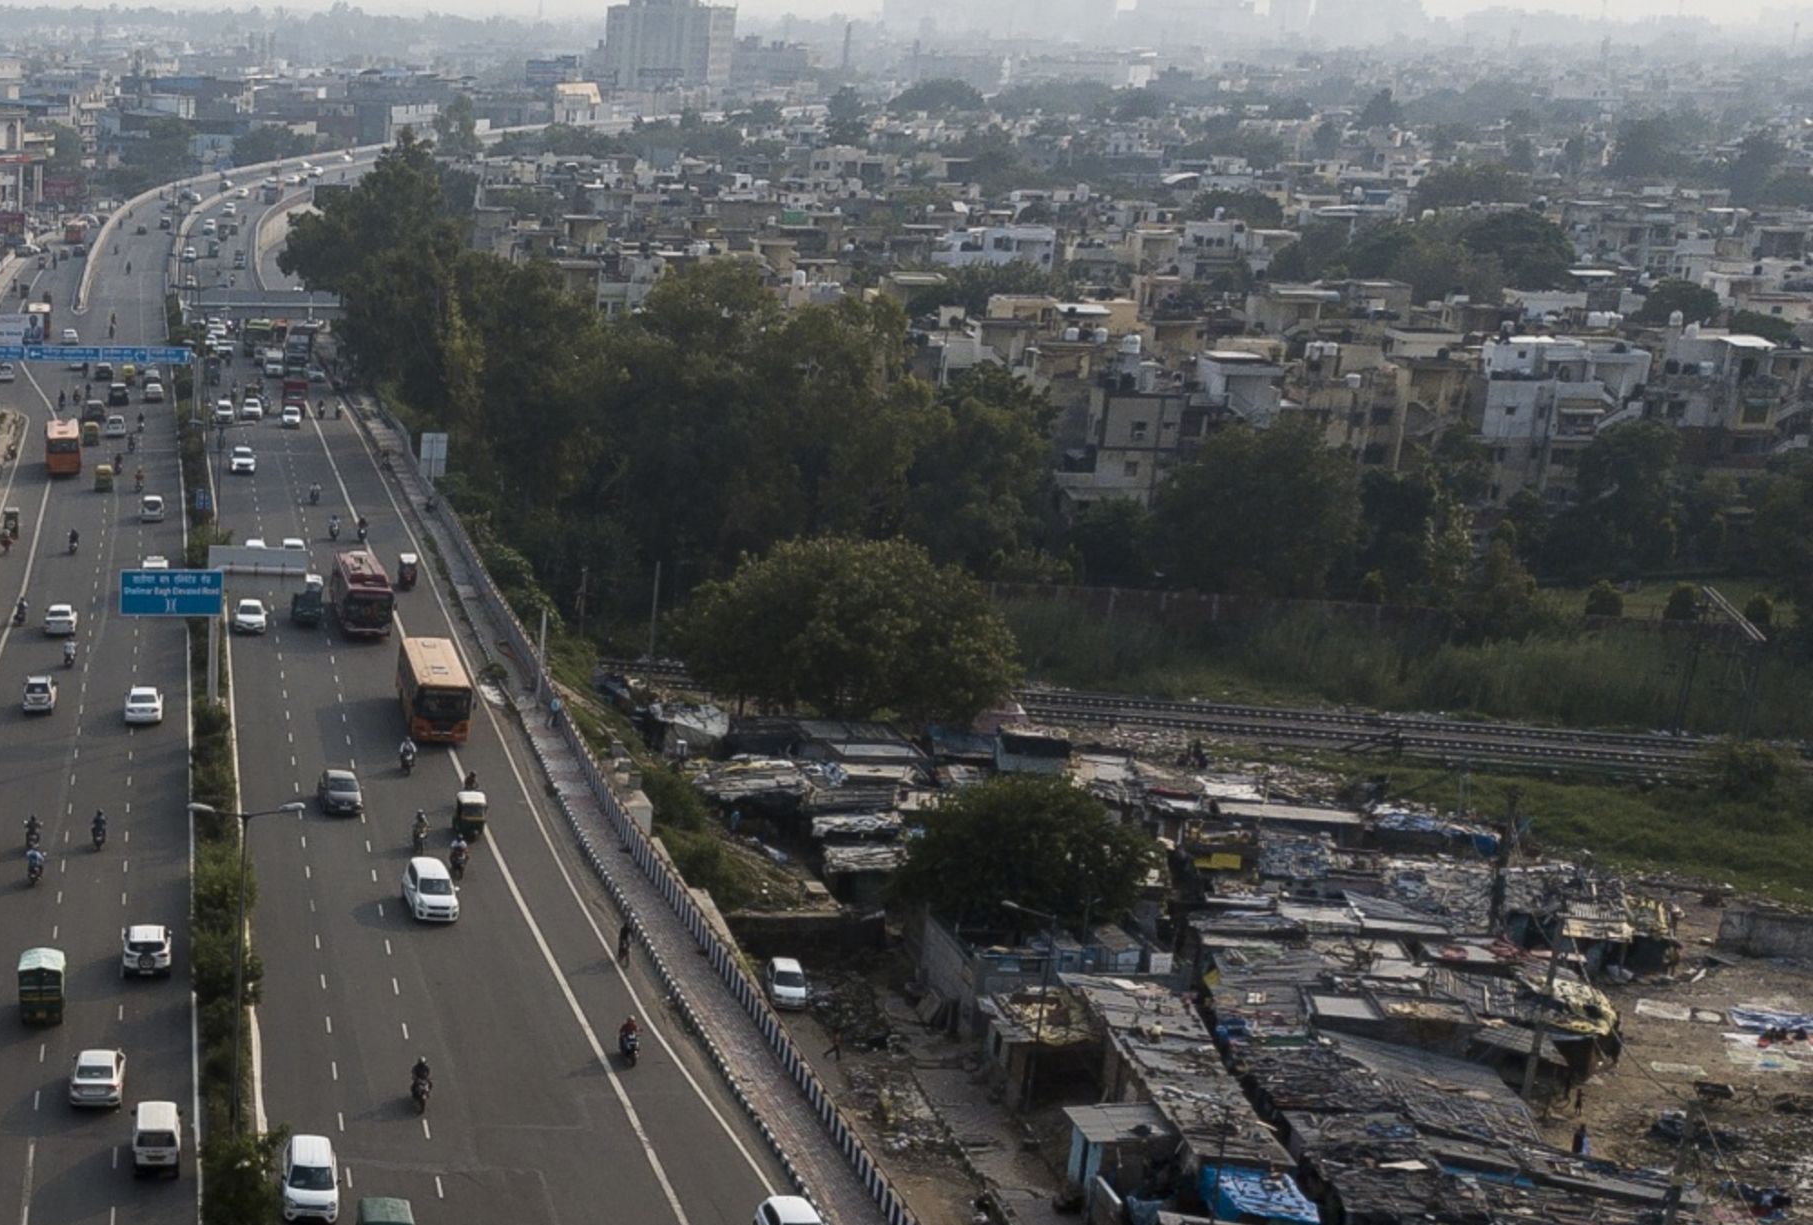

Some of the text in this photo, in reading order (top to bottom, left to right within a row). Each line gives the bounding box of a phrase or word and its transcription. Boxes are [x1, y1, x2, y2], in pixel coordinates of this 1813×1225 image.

[124, 586, 220, 597] Shalimar Bagh Elevated Road
